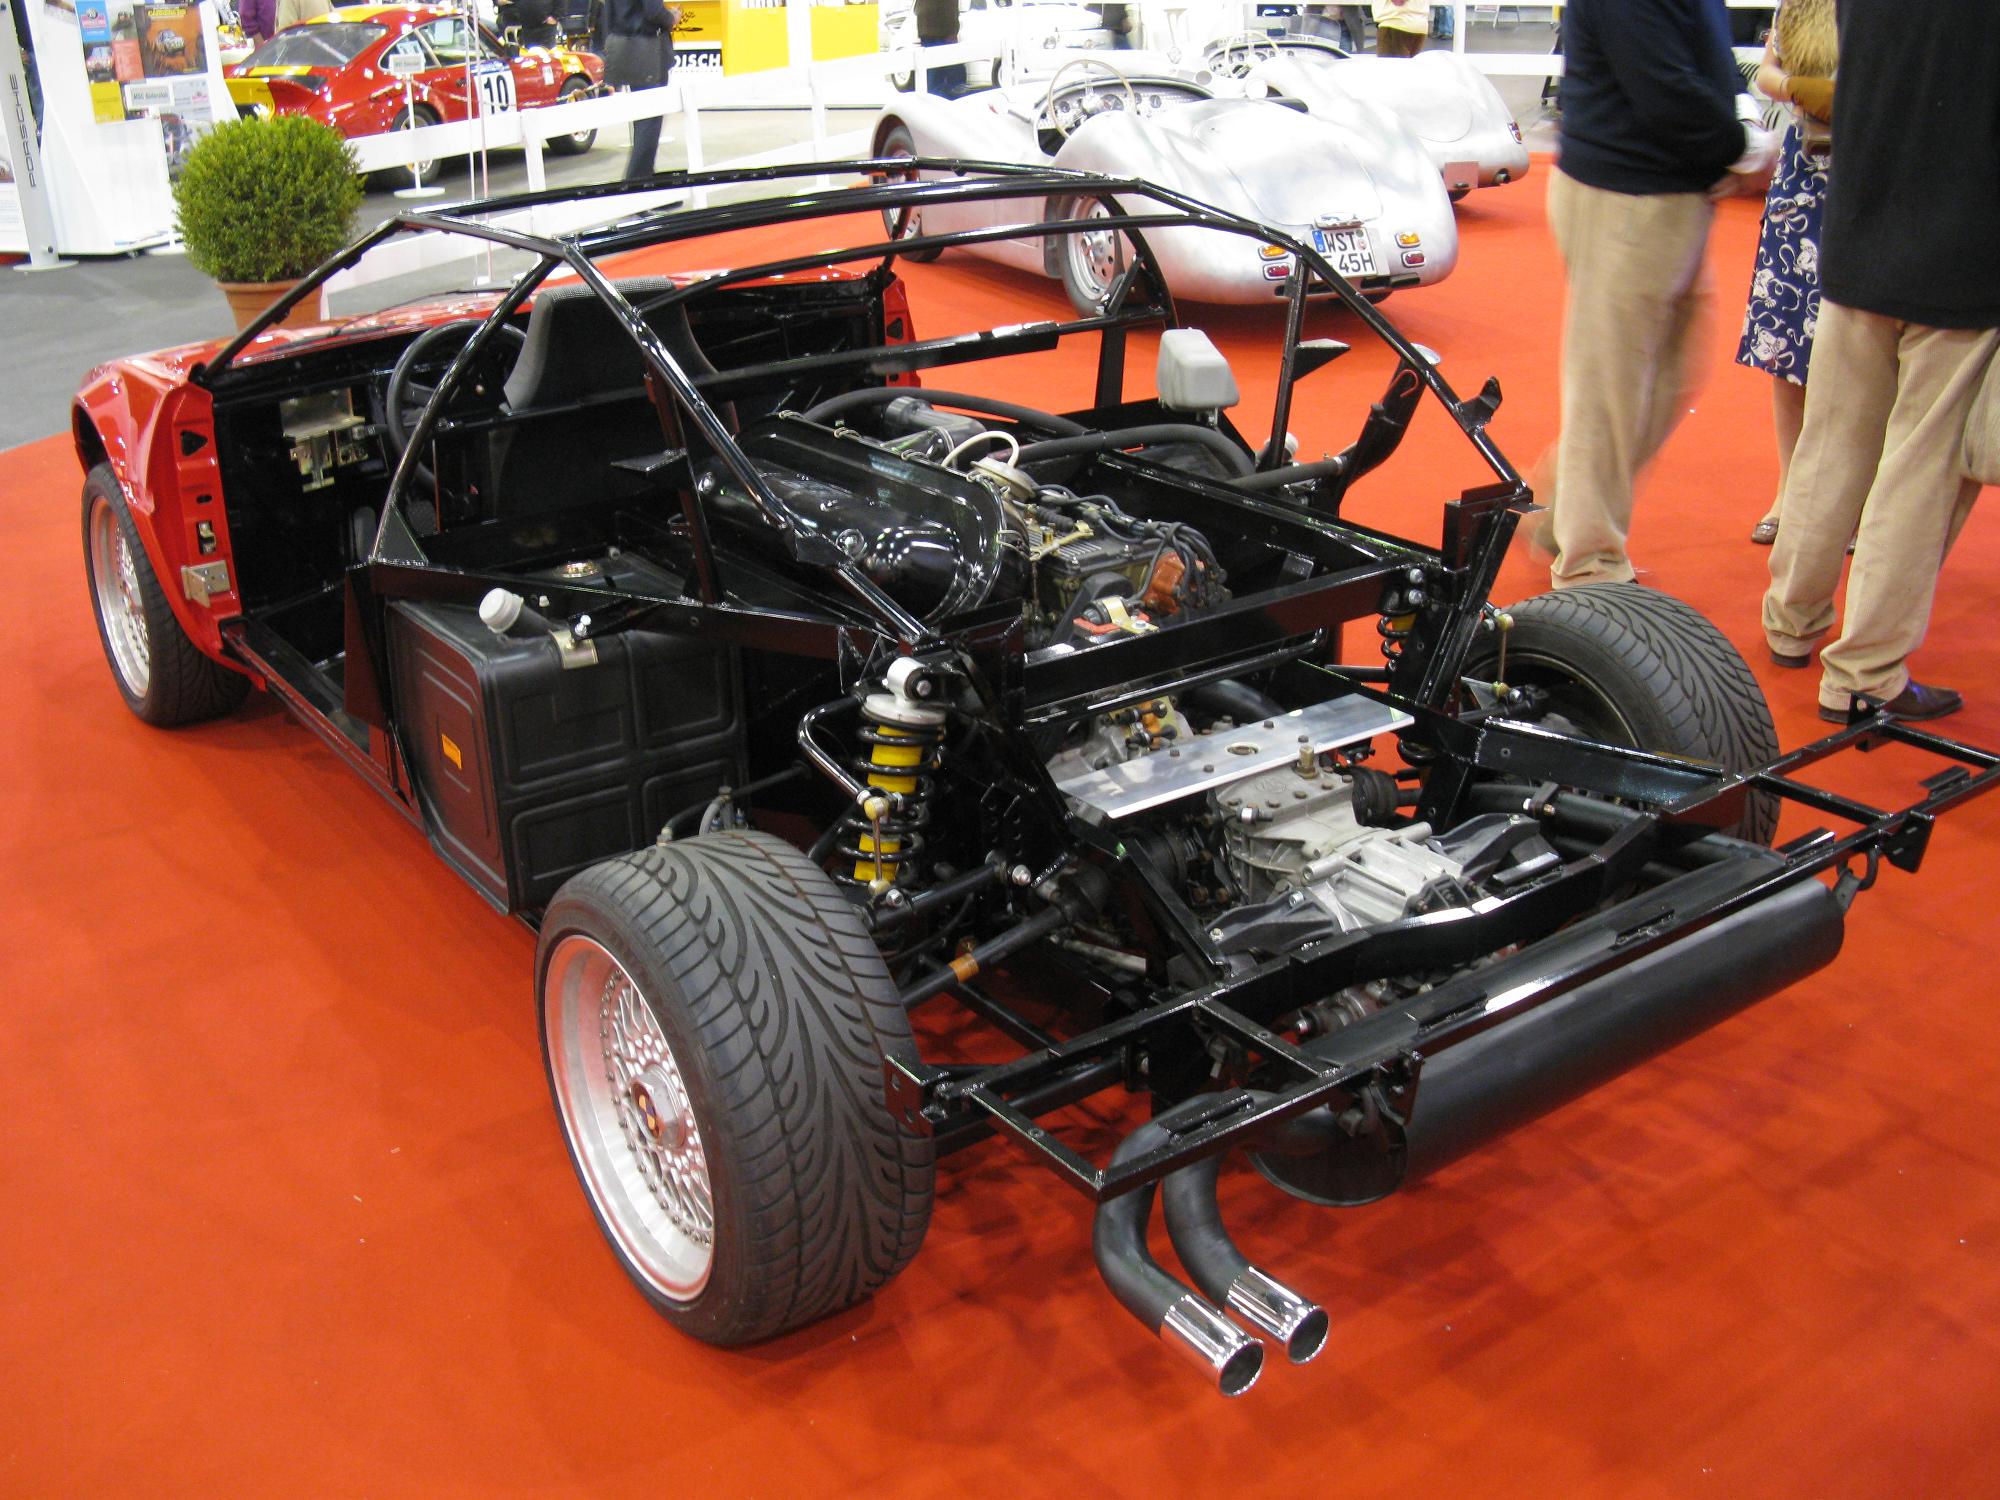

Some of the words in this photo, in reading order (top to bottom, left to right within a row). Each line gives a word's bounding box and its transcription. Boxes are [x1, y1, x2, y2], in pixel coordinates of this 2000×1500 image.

[484, 75, 508, 114] 10
[10, 74, 36, 188] PORSCHE
[1324, 231, 1355, 252] WST
[1339, 252, 1374, 273] 45H
